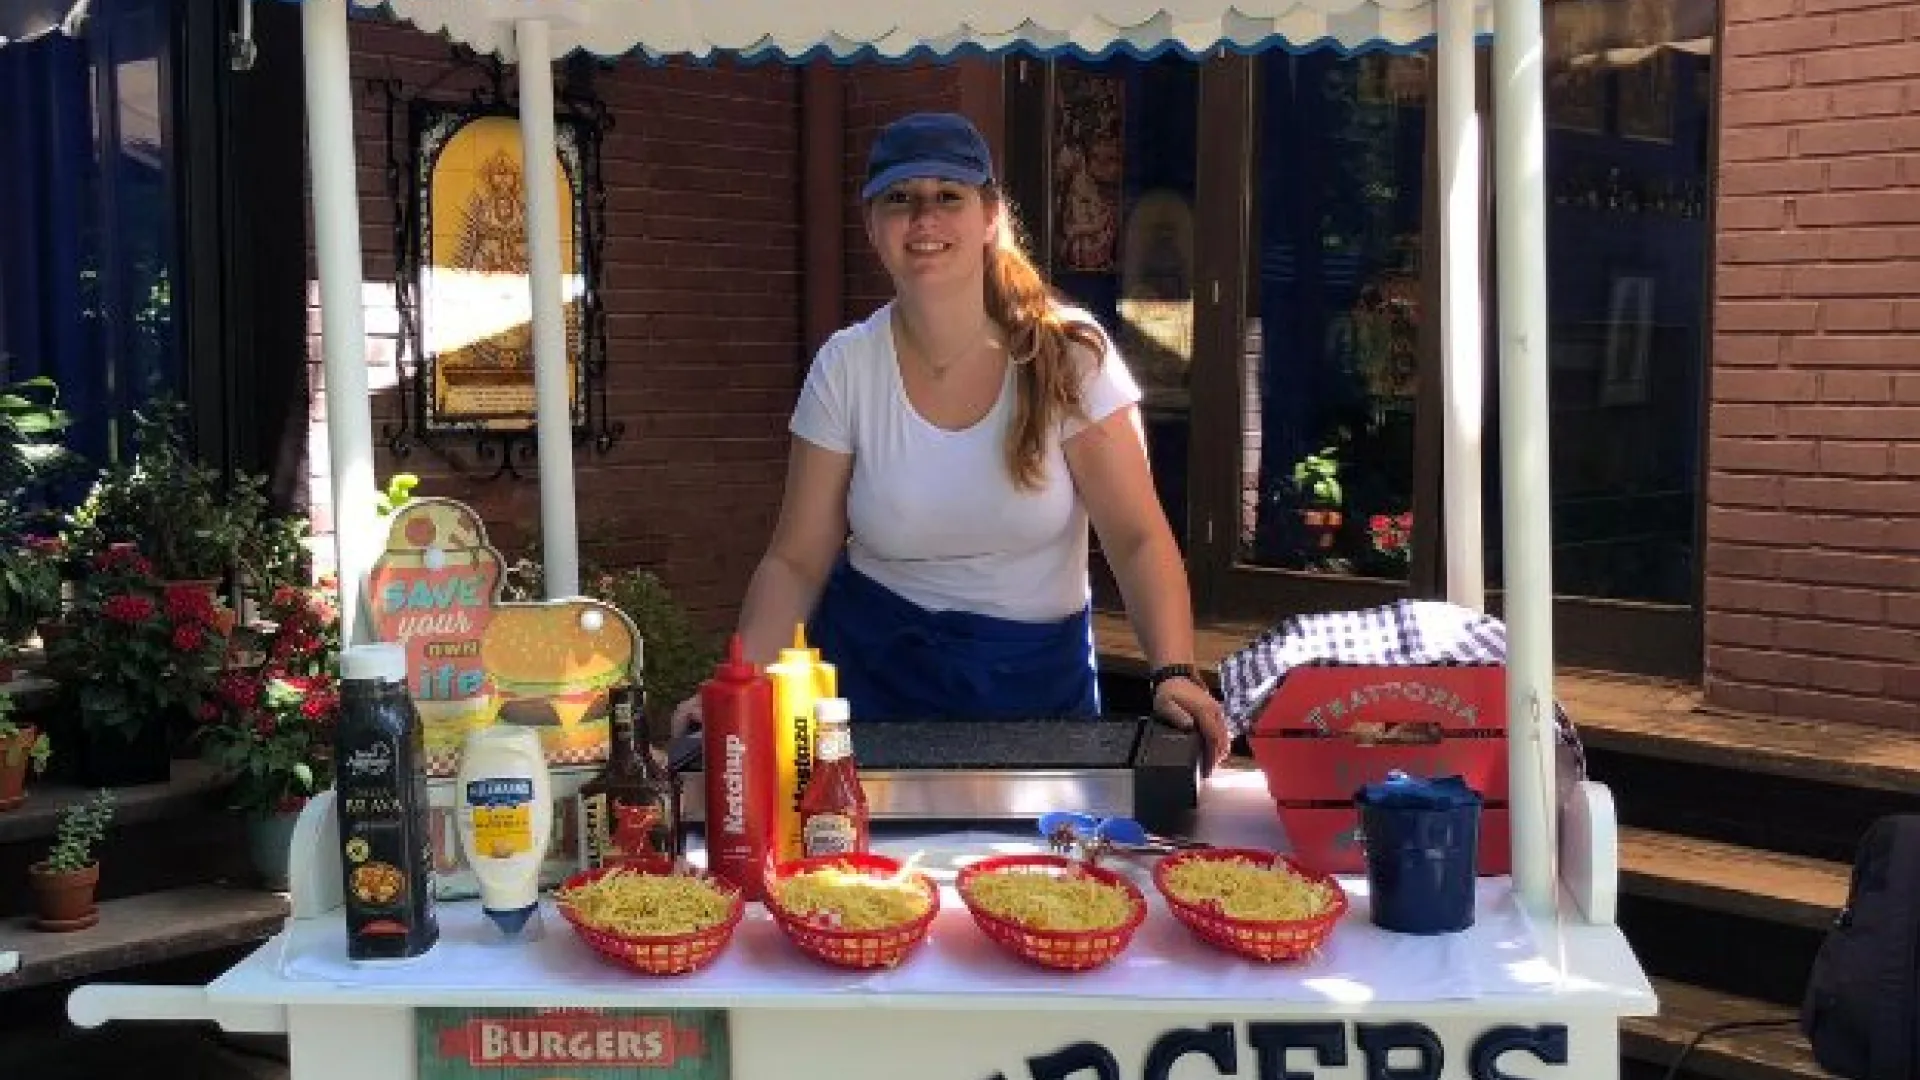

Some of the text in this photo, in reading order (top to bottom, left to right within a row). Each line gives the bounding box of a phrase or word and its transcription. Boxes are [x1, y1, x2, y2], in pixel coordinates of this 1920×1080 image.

[383, 575, 485, 613] SAVE
[397, 611, 473, 645] your
[419, 664, 483, 700] ife
[1305, 681, 1479, 735] TRATTORIA
[722, 734, 747, 835] Ketchup
[481, 1024, 663, 1060] BURGERS
